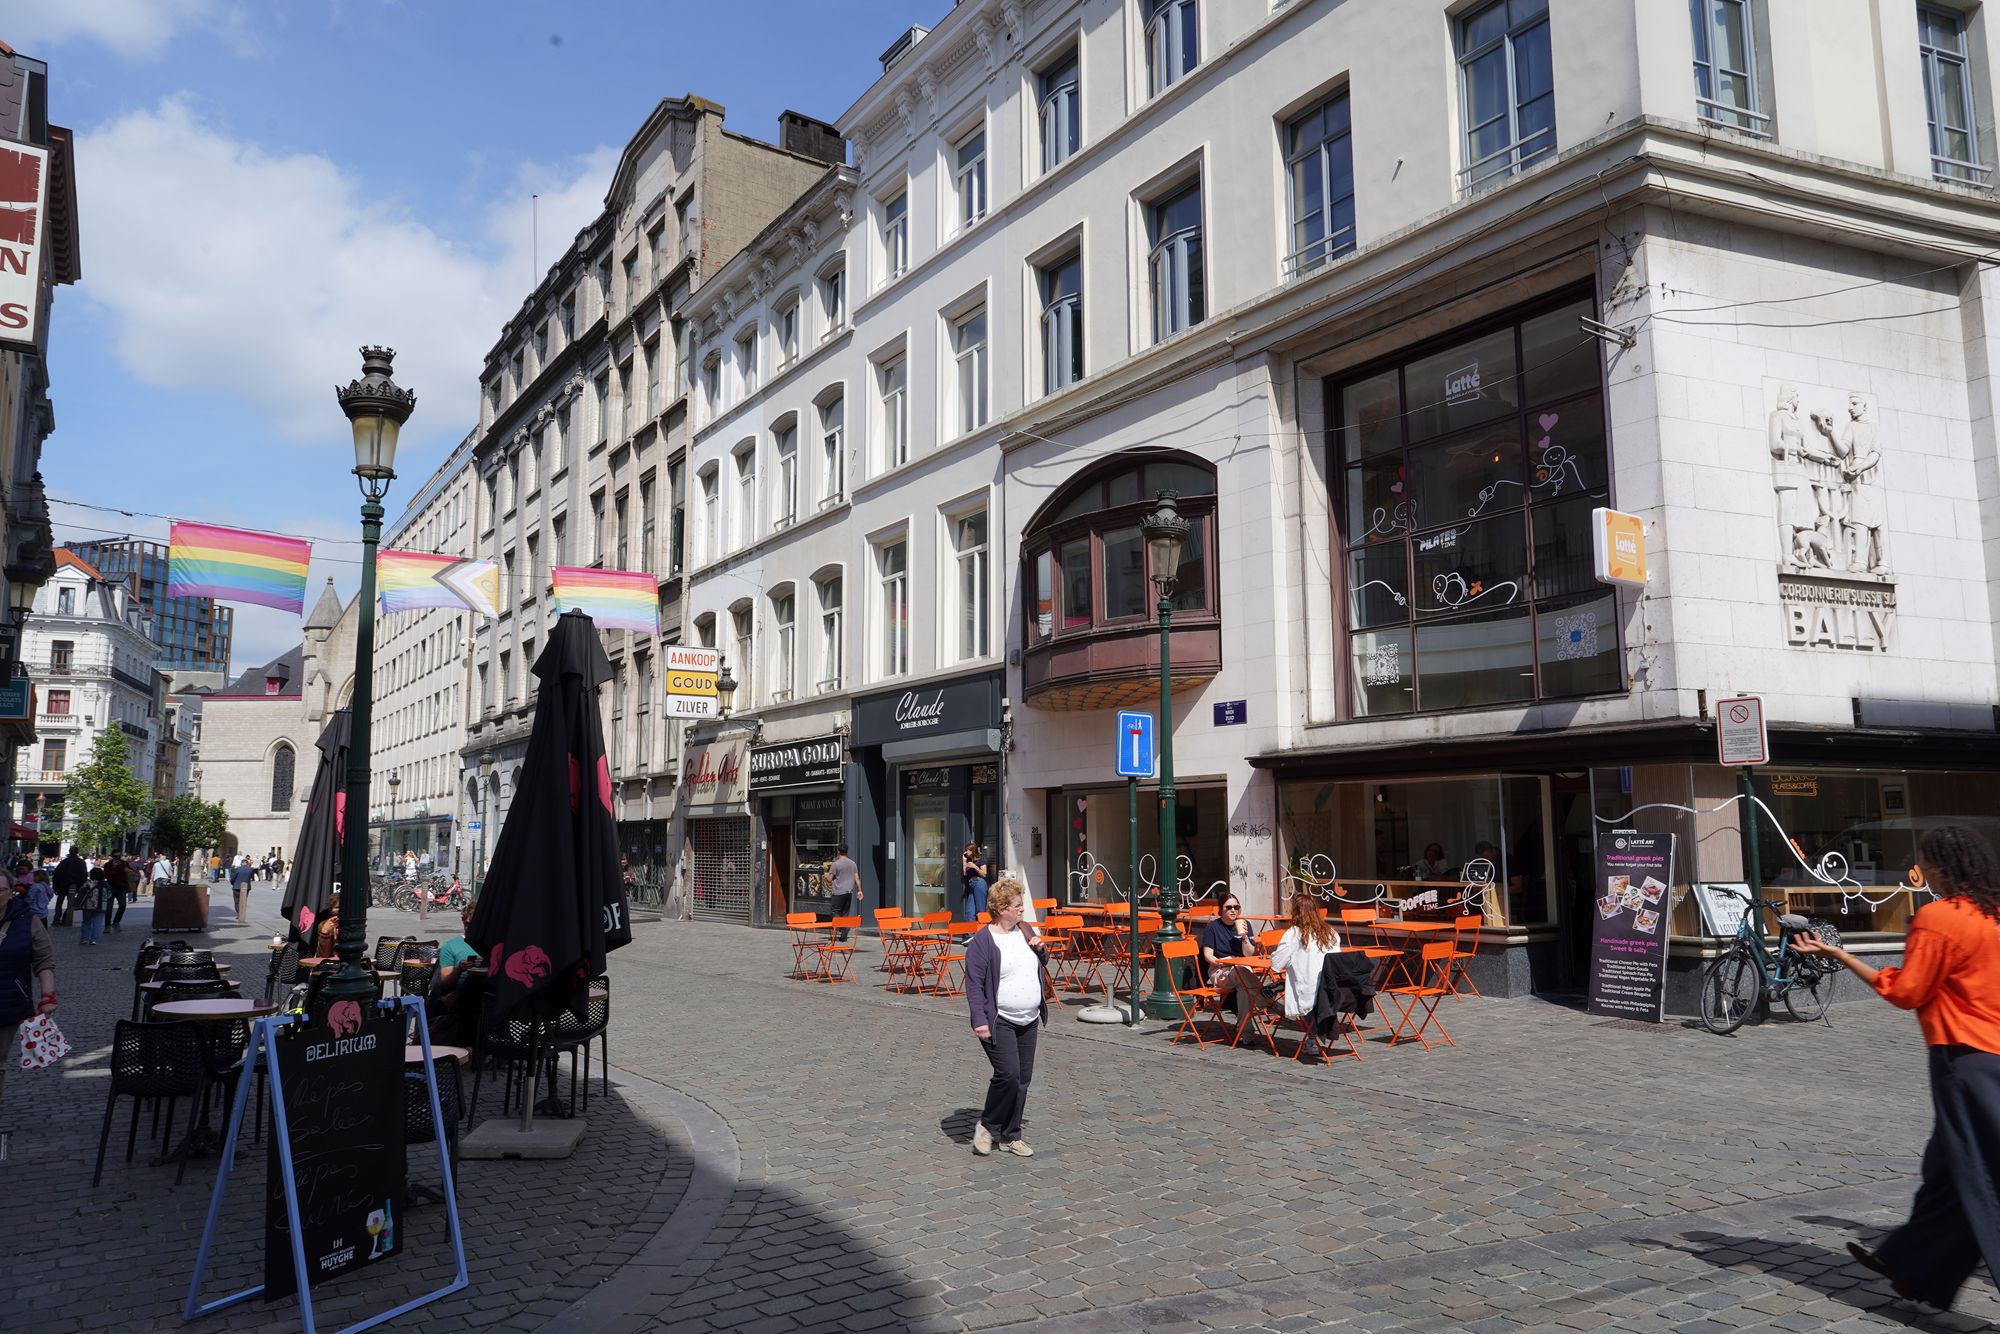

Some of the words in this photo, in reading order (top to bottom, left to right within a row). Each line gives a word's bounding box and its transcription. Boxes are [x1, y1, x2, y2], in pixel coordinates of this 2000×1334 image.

[1420, 529, 1457, 551] PILATES
[1441, 540, 1456, 549] TIME
[1780, 583, 1849, 603] CORDONNERIE
[1850, 590, 1880, 607] SUISSE
[1786, 604, 1894, 652] BALLY
[671, 652, 716, 666] AANKOOP
[673, 677, 712, 689] GOUD
[676, 701, 708, 714] ZILVER
[896, 689, 944, 722] Claude
[751, 748, 801, 772] EUROPA
[801, 742, 840, 765] GOLD
[684, 751, 716, 799] Golden
[718, 754, 738, 784] Arts
[1400, 890, 1438, 911] COFFEE
[1423, 903, 1438, 911] TIME
[306, 1034, 377, 1062] DELIRIUM
[321, 1250, 354, 1270] HUYGHE
